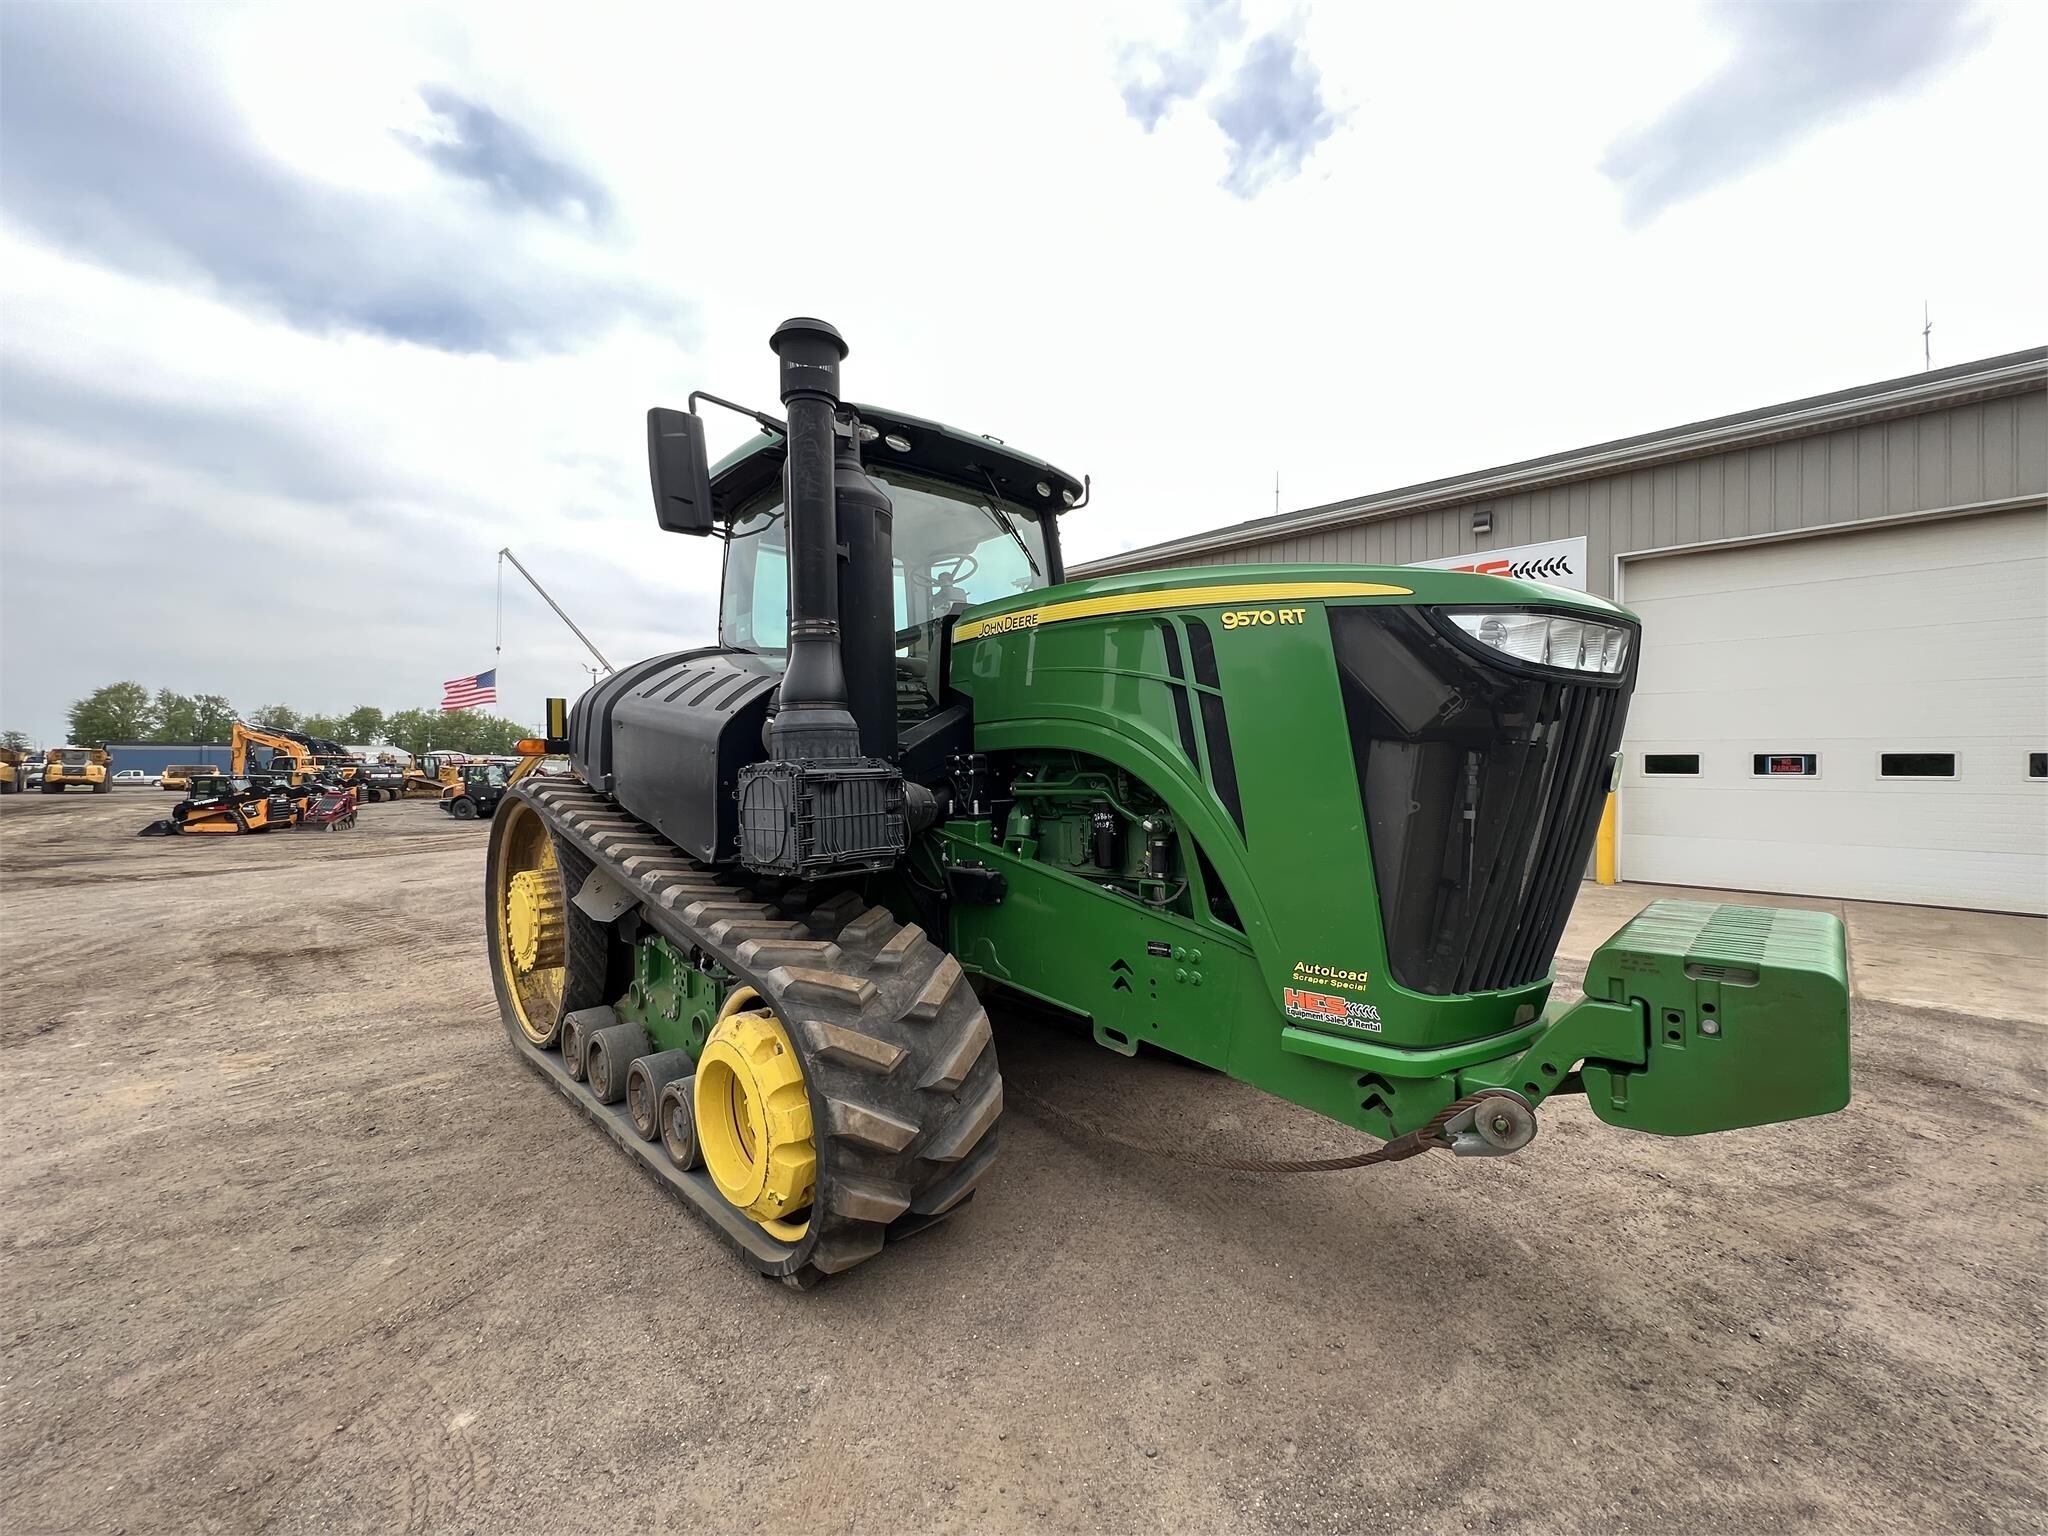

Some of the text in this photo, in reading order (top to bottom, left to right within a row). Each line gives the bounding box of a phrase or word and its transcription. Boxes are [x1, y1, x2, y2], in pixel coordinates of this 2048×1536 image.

[978, 614, 1039, 638] JOHN DEERE
[1221, 608, 1306, 630] 9570 RT
[1292, 972, 1367, 992] Scraper Special
[1294, 961, 1368, 982] AutoLoad
[1284, 988, 1348, 1017] HES
[1287, 1008, 1381, 1032] Equipment Sales & Rental
